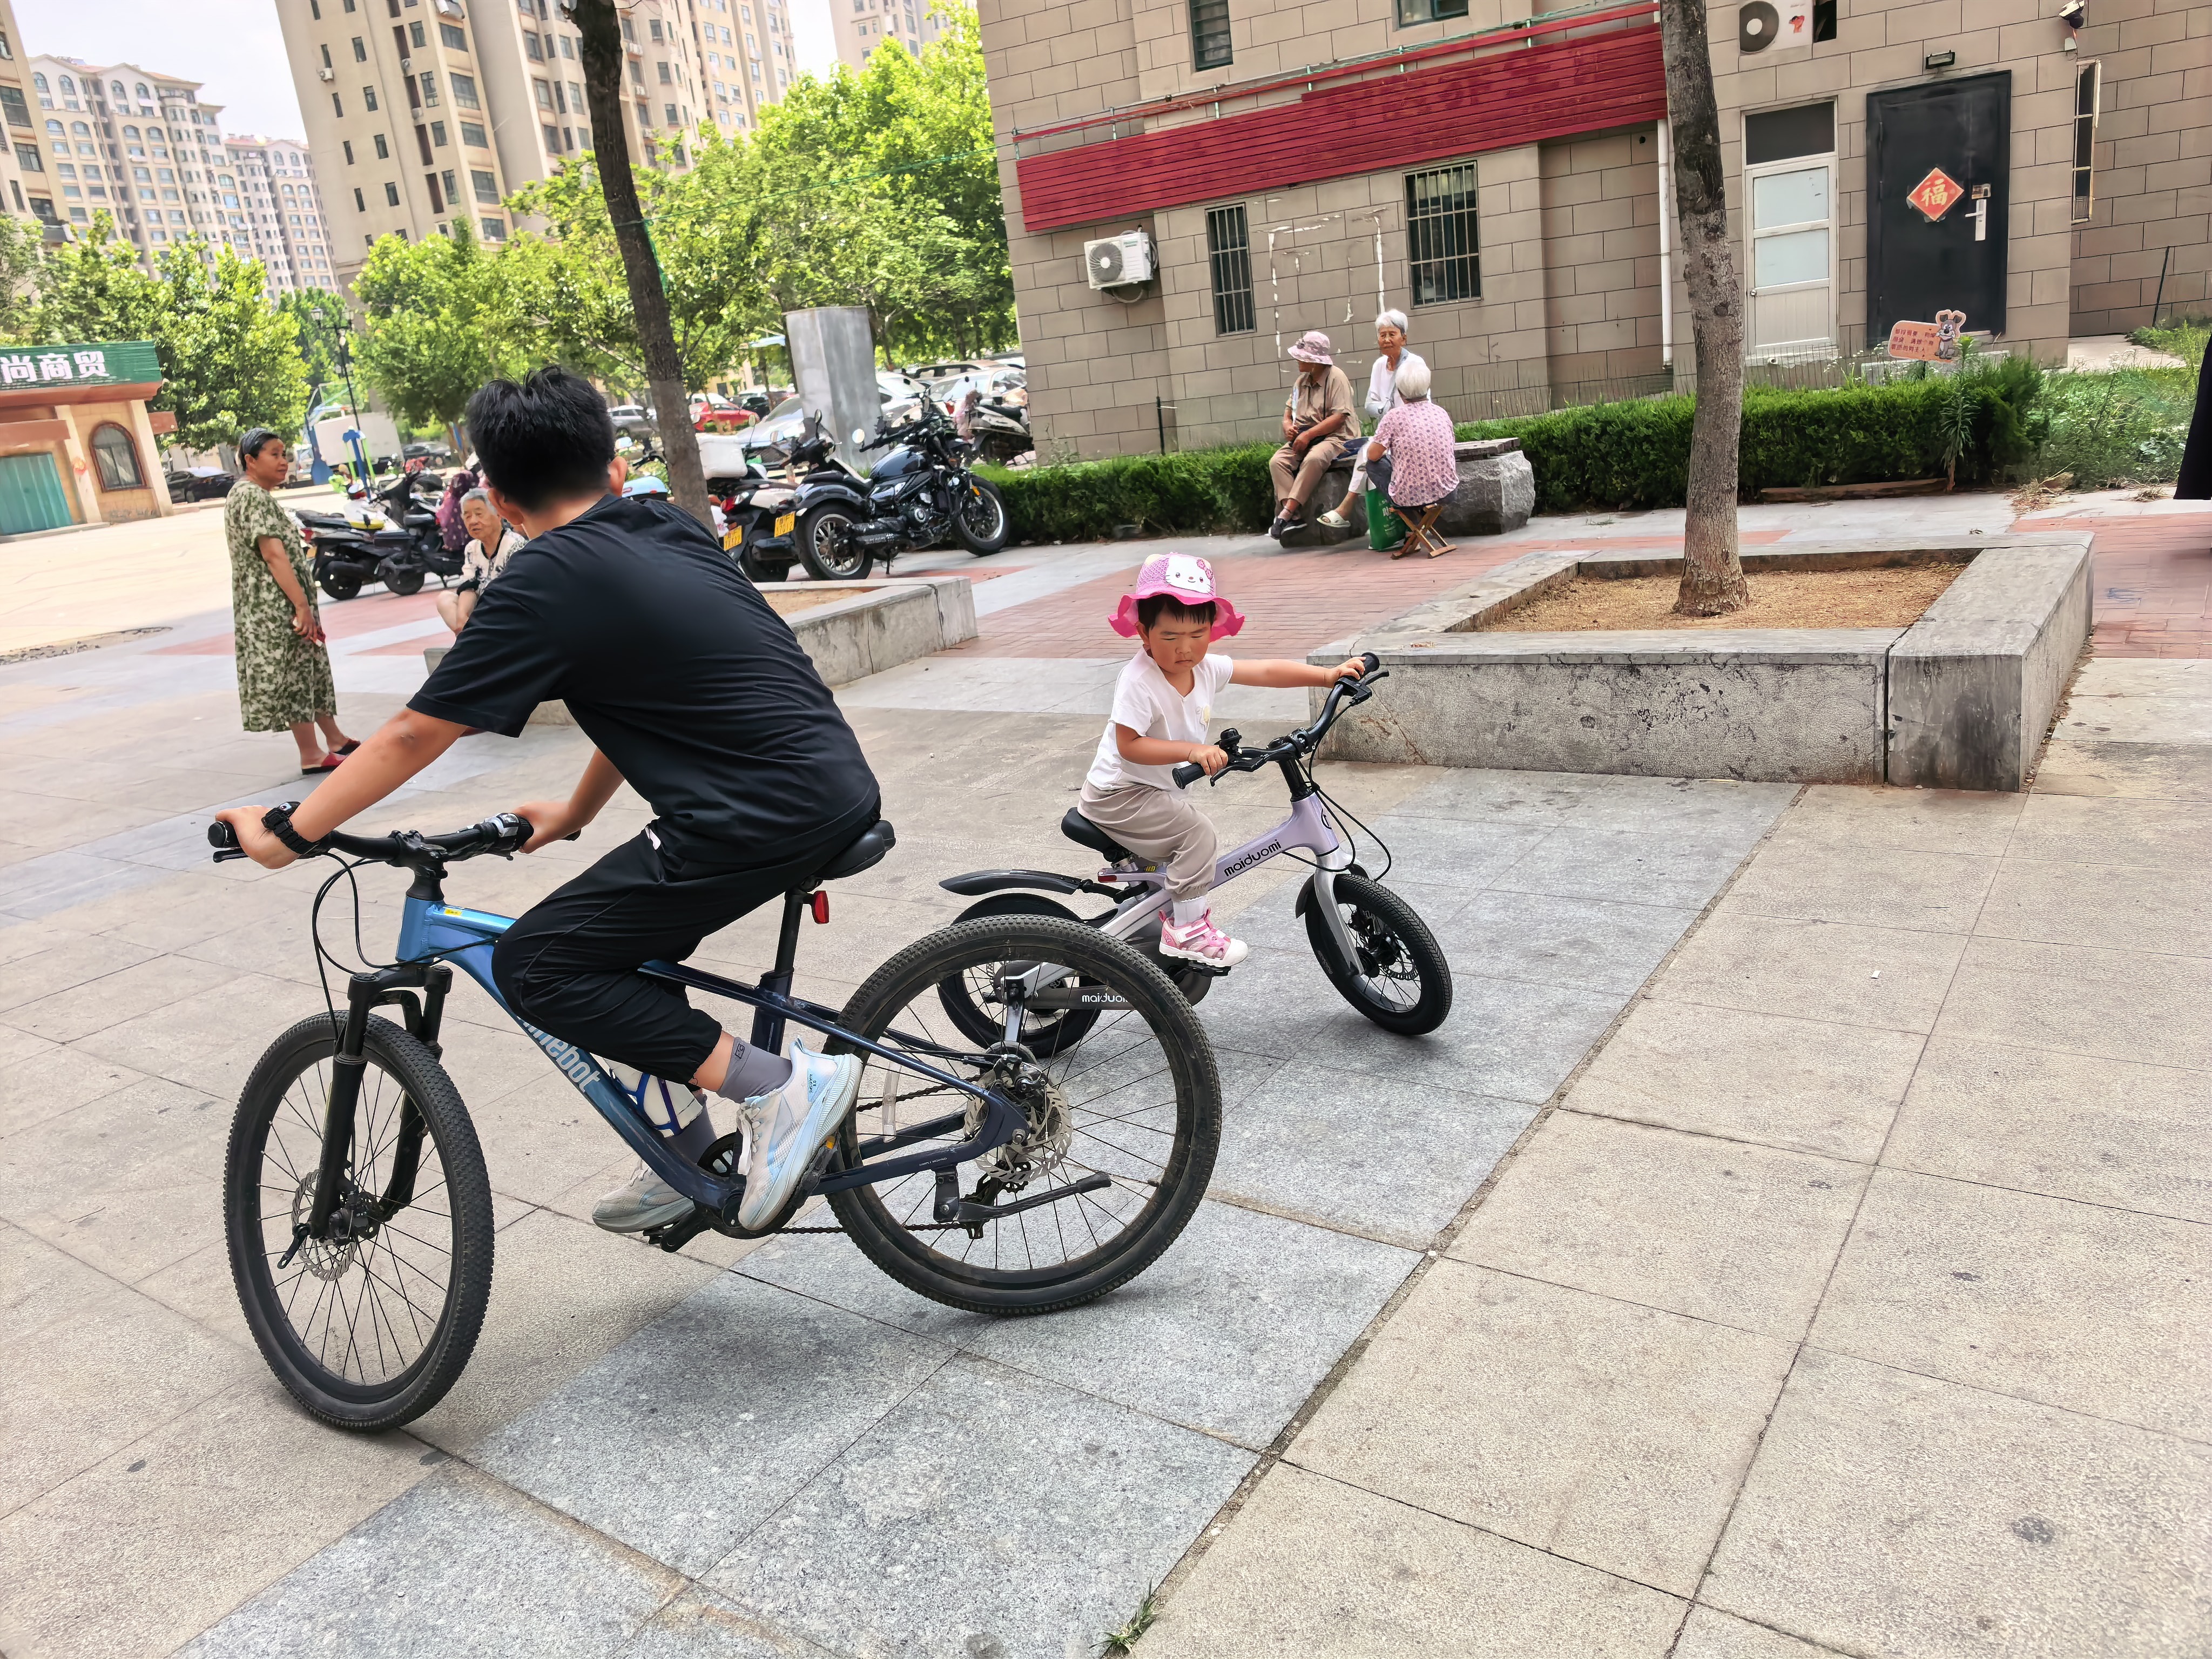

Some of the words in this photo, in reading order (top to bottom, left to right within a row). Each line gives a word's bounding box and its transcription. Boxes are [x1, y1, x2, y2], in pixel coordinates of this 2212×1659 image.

[1920, 178, 1948, 207] 福
[0, 351, 110, 383] 尚商贸
[1224, 839, 1282, 876] maiduomi
[517, 1016, 601, 1093] ebot
